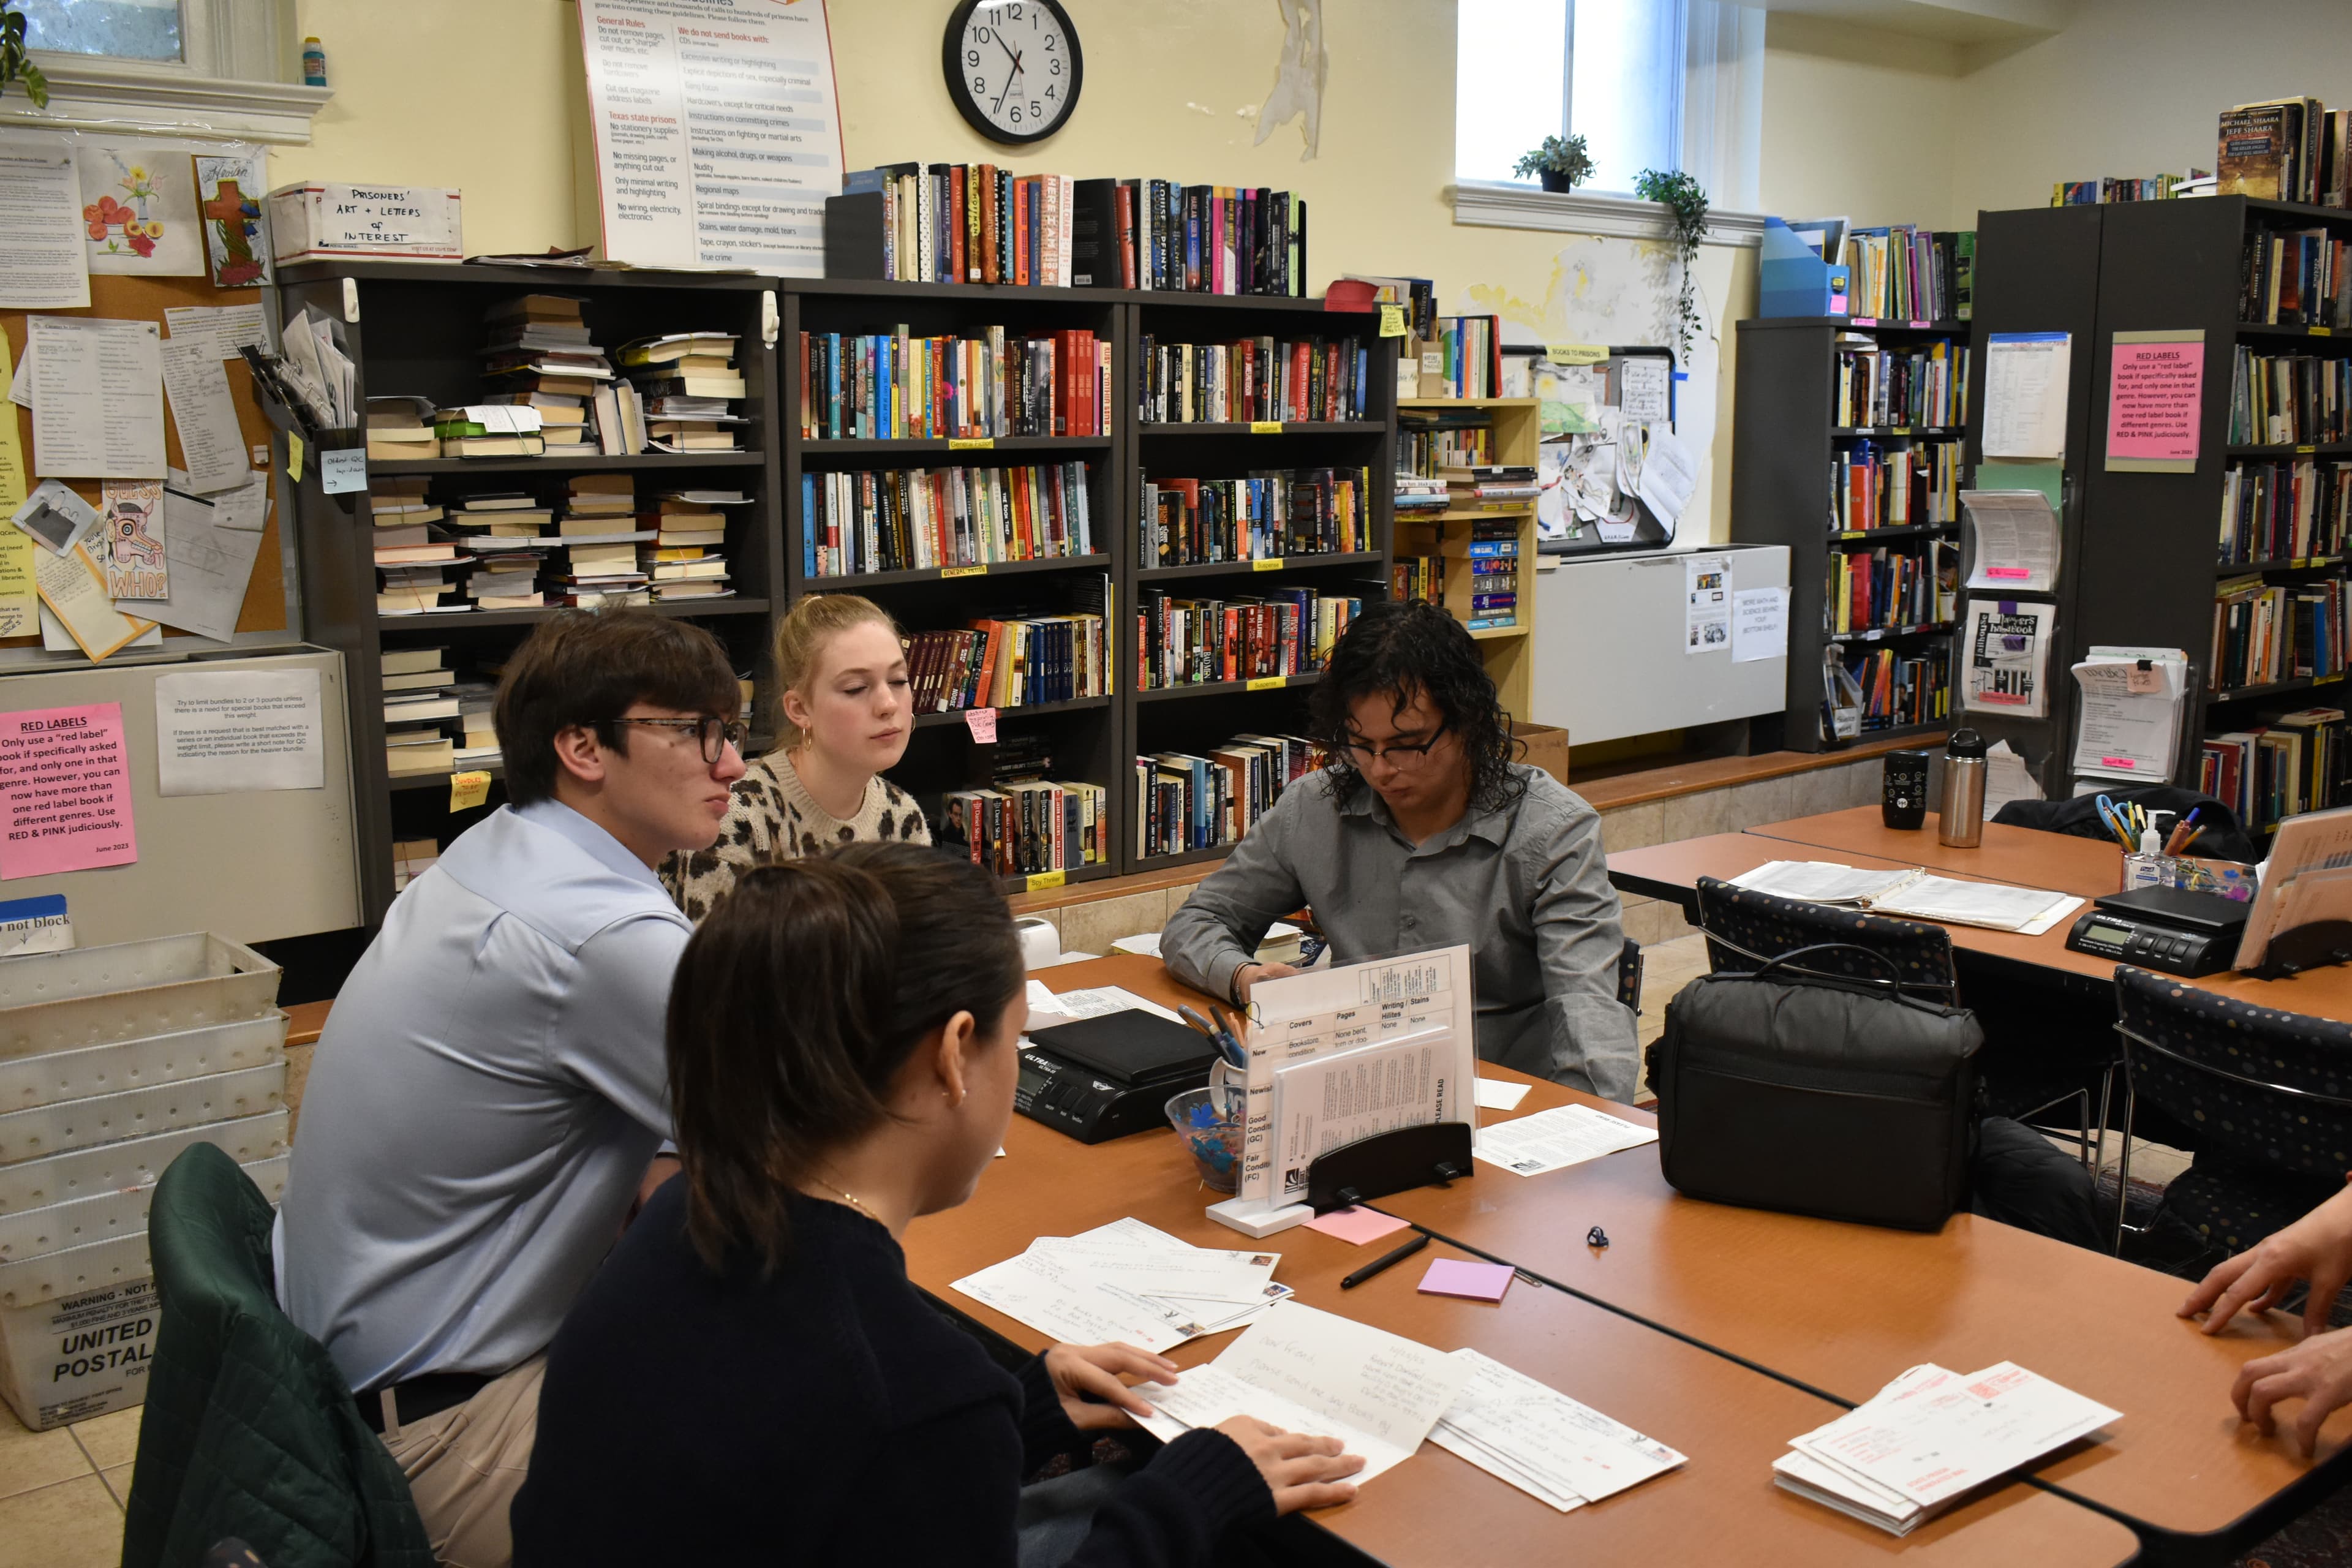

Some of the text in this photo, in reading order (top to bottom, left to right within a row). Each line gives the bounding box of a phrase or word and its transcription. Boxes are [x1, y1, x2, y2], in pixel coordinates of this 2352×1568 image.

[989, 9, 1000, 26] 11
[1006, 3, 1022, 20] 12
[597, 16, 646, 28] General Rules
[1032, 13, 1037, 30] 1
[677, 26, 689, 35] We
[731, 33, 751, 42] books
[972, 26, 990, 43] 10
[1044, 34, 1054, 51] 2
[968, 50, 979, 67] 9
[1050, 59, 1060, 75] 3
[974, 77, 985, 94] 8
[1044, 84, 1055, 100] 4
[990, 97, 1000, 114] 7
[1030, 100, 1041, 118] 5
[608, 111, 676, 124] Texas state prisons
[1010, 107, 1021, 123] 6
[2221, 119, 2252, 127] MICHAEL
[620, 124, 652, 134] stationery
[692, 148, 714, 158] Making
[739, 152, 758, 160] drugs,
[694, 163, 714, 173] Nudity
[696, 185, 722, 195] Regional
[1047, 178, 1056, 212] HERE
[337, 205, 357, 214] ART
[381, 206, 420, 217] LETTERS
[698, 223, 718, 232] Stains,
[738, 225, 763, 234] damage,
[345, 232, 409, 242] INTEREST
[1047, 228, 1056, 251] AM
[106, 480, 161, 500] GUESS
[110, 571, 167, 597] WHO?
[1254, 680, 1277, 689] Suspense
[21, 716, 87, 731] RED LABELS
[2, 737, 24, 747] Only
[24, 750, 31, 758] if
[33, 744, 86, 758] specifically
[89, 741, 116, 752] asked
[0, 766, 17, 774] for,
[20, 763, 38, 772] and
[40, 761, 61, 771] only
[97, 755, 117, 764] that
[0, 779, 31, 790] genre.
[33, 774, 80, 785] However,
[83, 771, 101, 780] you
[34, 801, 50, 810] red
[53, 797, 77, 808] label
[80, 795, 104, 805] book
[13, 814, 57, 826] different
[59, 811, 95, 823] genres.
[9, 820, 123, 840] RED & PINK judiciously.
[7, 913, 70, 931] not block
[1289, 1020, 1312, 1029] Covers
[1336, 1011, 1355, 1020] Pages
[1382, 1001, 1404, 1011] Writing
[1382, 1011, 1401, 1020] Hilites
[1289, 1038, 1319, 1049] Bookstore
[1336, 1030, 1351, 1039] None
[1289, 1047, 1315, 1058] condition
[1248, 1115, 1266, 1125] Good
[1247, 1134, 1262, 1144] (GC)
[1245, 1173, 1259, 1182] (FC)
[61, 1284, 148, 1311] WARNING NOT
[62, 1318, 153, 1354] UNITED
[53, 1343, 152, 1382] POSTAL
[126, 1366, 145, 1377] FOR
